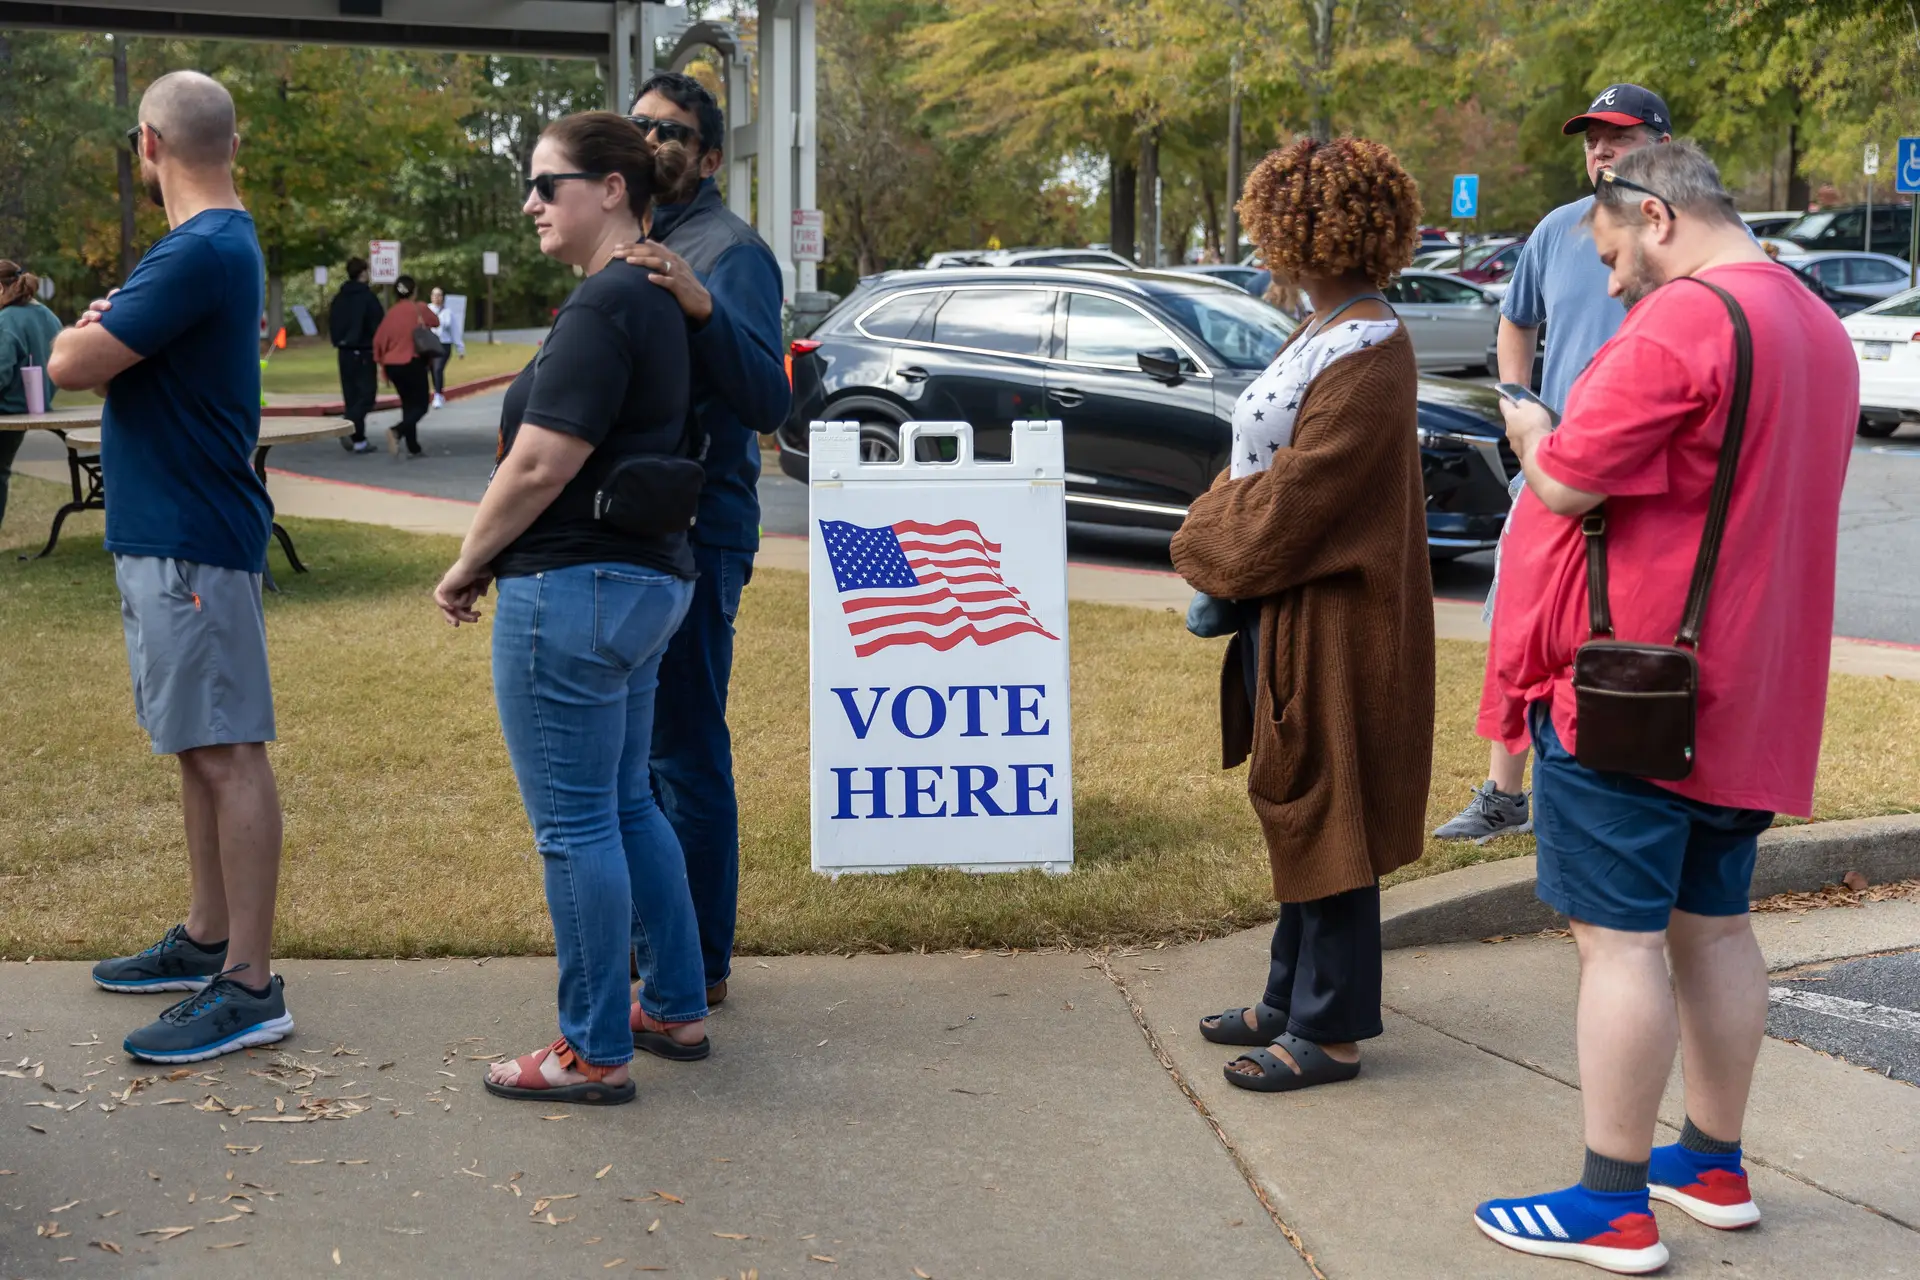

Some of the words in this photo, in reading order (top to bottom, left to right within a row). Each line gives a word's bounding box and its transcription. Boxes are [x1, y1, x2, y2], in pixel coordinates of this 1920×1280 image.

[794, 242, 818, 254] LANE
[796, 229, 817, 241] FIRE
[831, 685, 1050, 740] VOTE
[830, 764, 1058, 820] HERE
